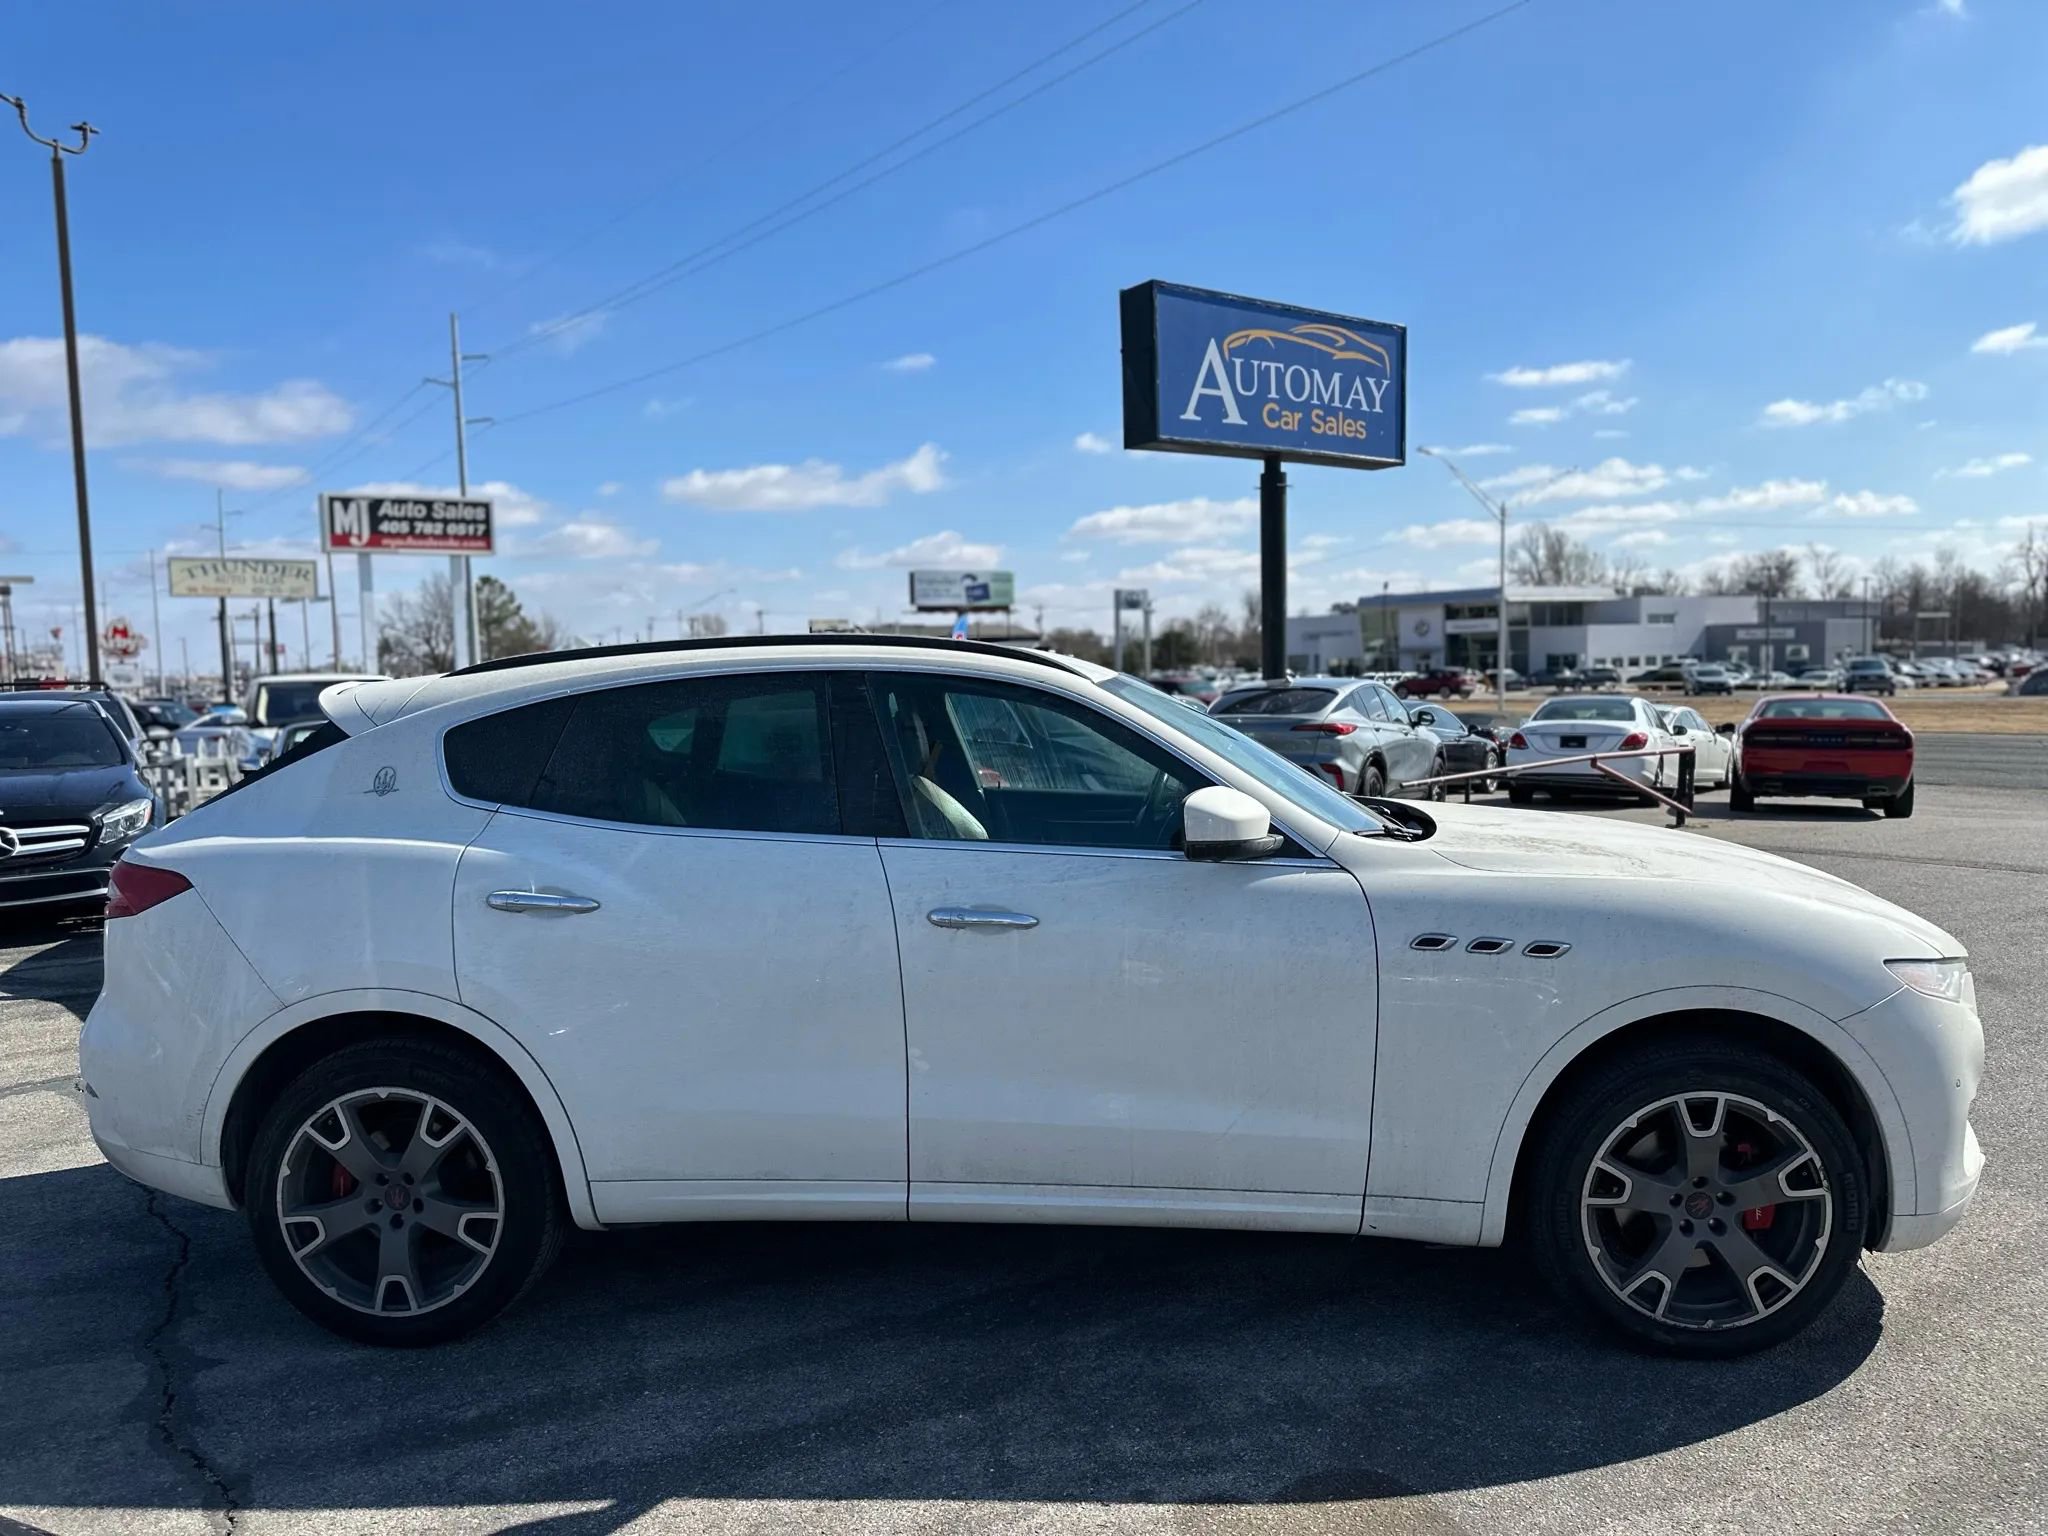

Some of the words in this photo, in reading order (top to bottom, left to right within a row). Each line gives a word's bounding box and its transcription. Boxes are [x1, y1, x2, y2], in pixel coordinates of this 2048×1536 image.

[1179, 337, 1391, 426] AUTOMAY
[1262, 402, 1303, 431] Car
[1311, 409, 1367, 440] Sales
[332, 499, 372, 547] MJ
[377, 500, 428, 519] Auto
[431, 502, 487, 521] Sales
[378, 520, 410, 535] 405
[180, 560, 311, 582] THUNDER
